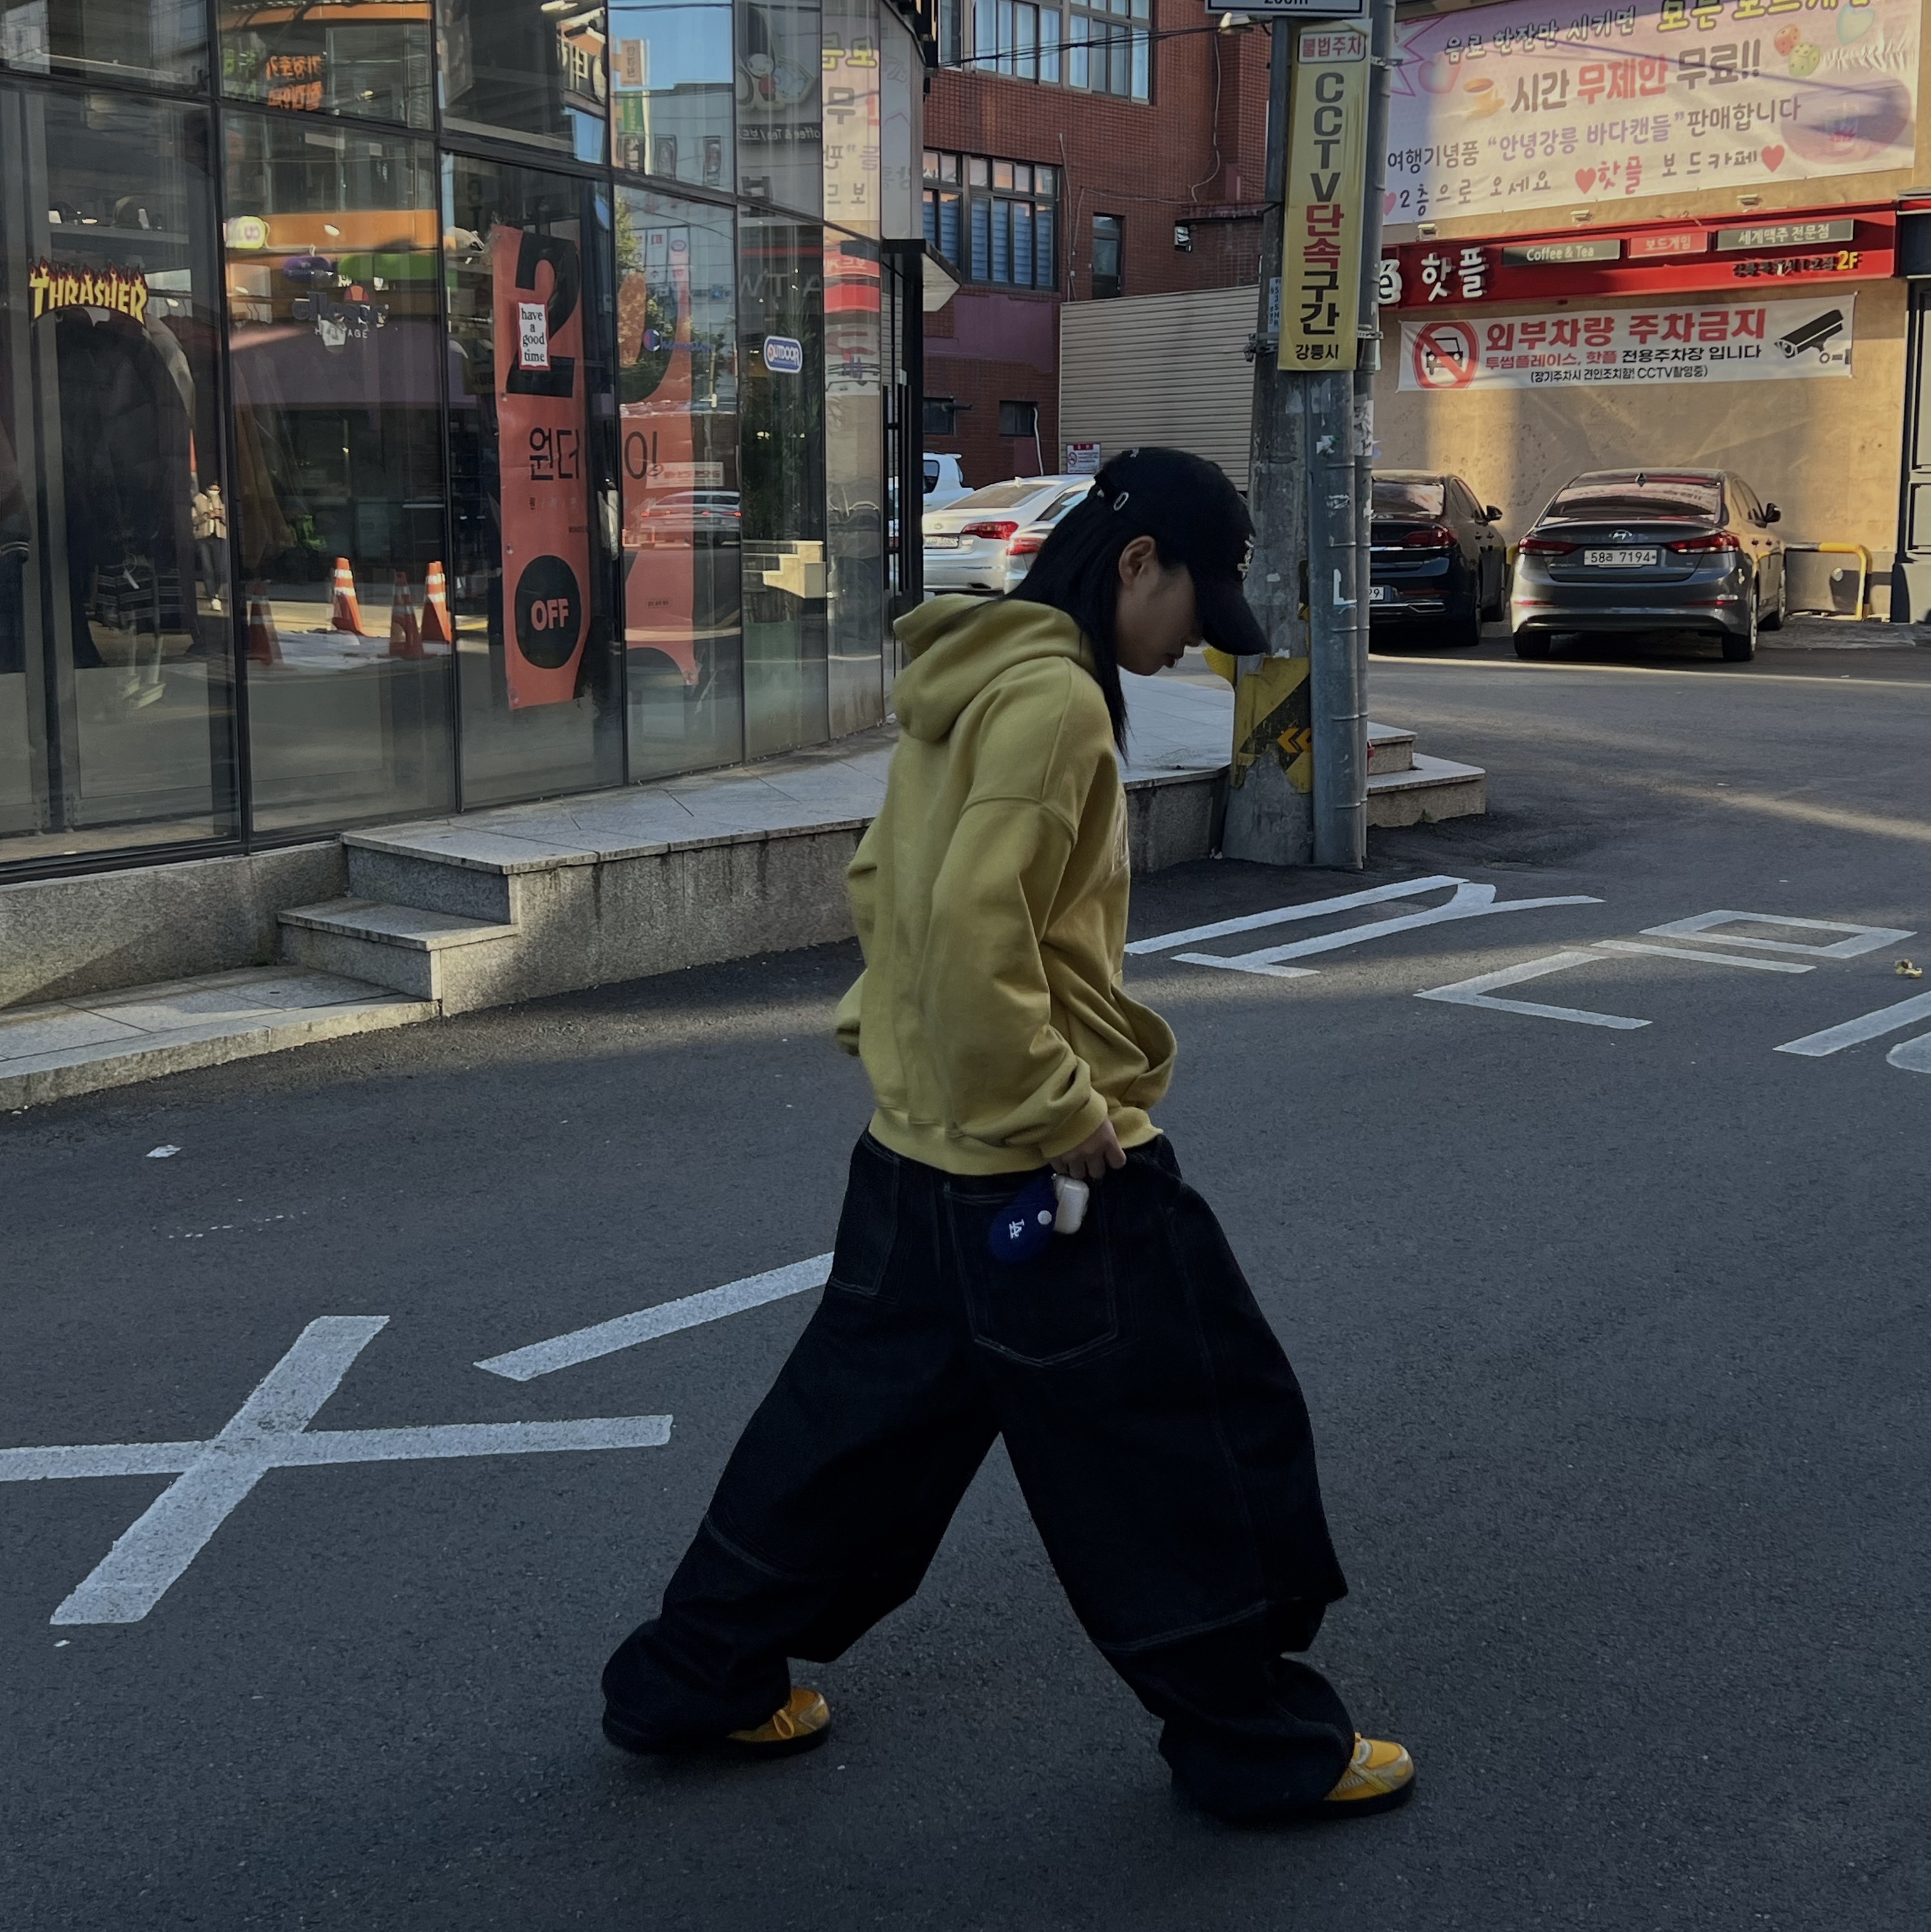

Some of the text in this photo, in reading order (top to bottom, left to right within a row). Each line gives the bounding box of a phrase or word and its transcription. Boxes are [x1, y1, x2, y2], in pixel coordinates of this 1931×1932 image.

[1445, 33, 1487, 64] 음료
[1493, 20, 1560, 53] 한잔만
[1567, 5, 1636, 41] 시키면
[1303, 36, 1362, 57] 불법주차
[1511, 39, 1761, 112] 시간 무제한 무료!!
[1388, 140, 1479, 174] 여행기념품
[1491, 170, 1552, 197] 오세요
[1645, 235, 1691, 251] 보드게임
[1738, 223, 1829, 245] 세계맥주 전문점
[1526, 245, 1594, 261] Coffee & Tea
[1837, 250, 1858, 270] 2F
[1420, 247, 1487, 302] 핫플
[29, 262, 147, 324] THRASHER
[522, 308, 543, 321] have
[530, 324, 536, 333] a
[1485, 308, 1766, 352] 외부차량 주차금지
[523, 332, 545, 348] good
[524, 349, 545, 362] time
[768, 344, 799, 366] OUTDOOR
[1296, 344, 1339, 360] 강릉시
[1485, 344, 1761, 370] 투썸플레이스, 핫플 전용주차장 입니다
[1531, 369, 1581, 383] (장기주차시
[1619, 552, 1650, 563] 7194
[531, 597, 569, 632] OFF
